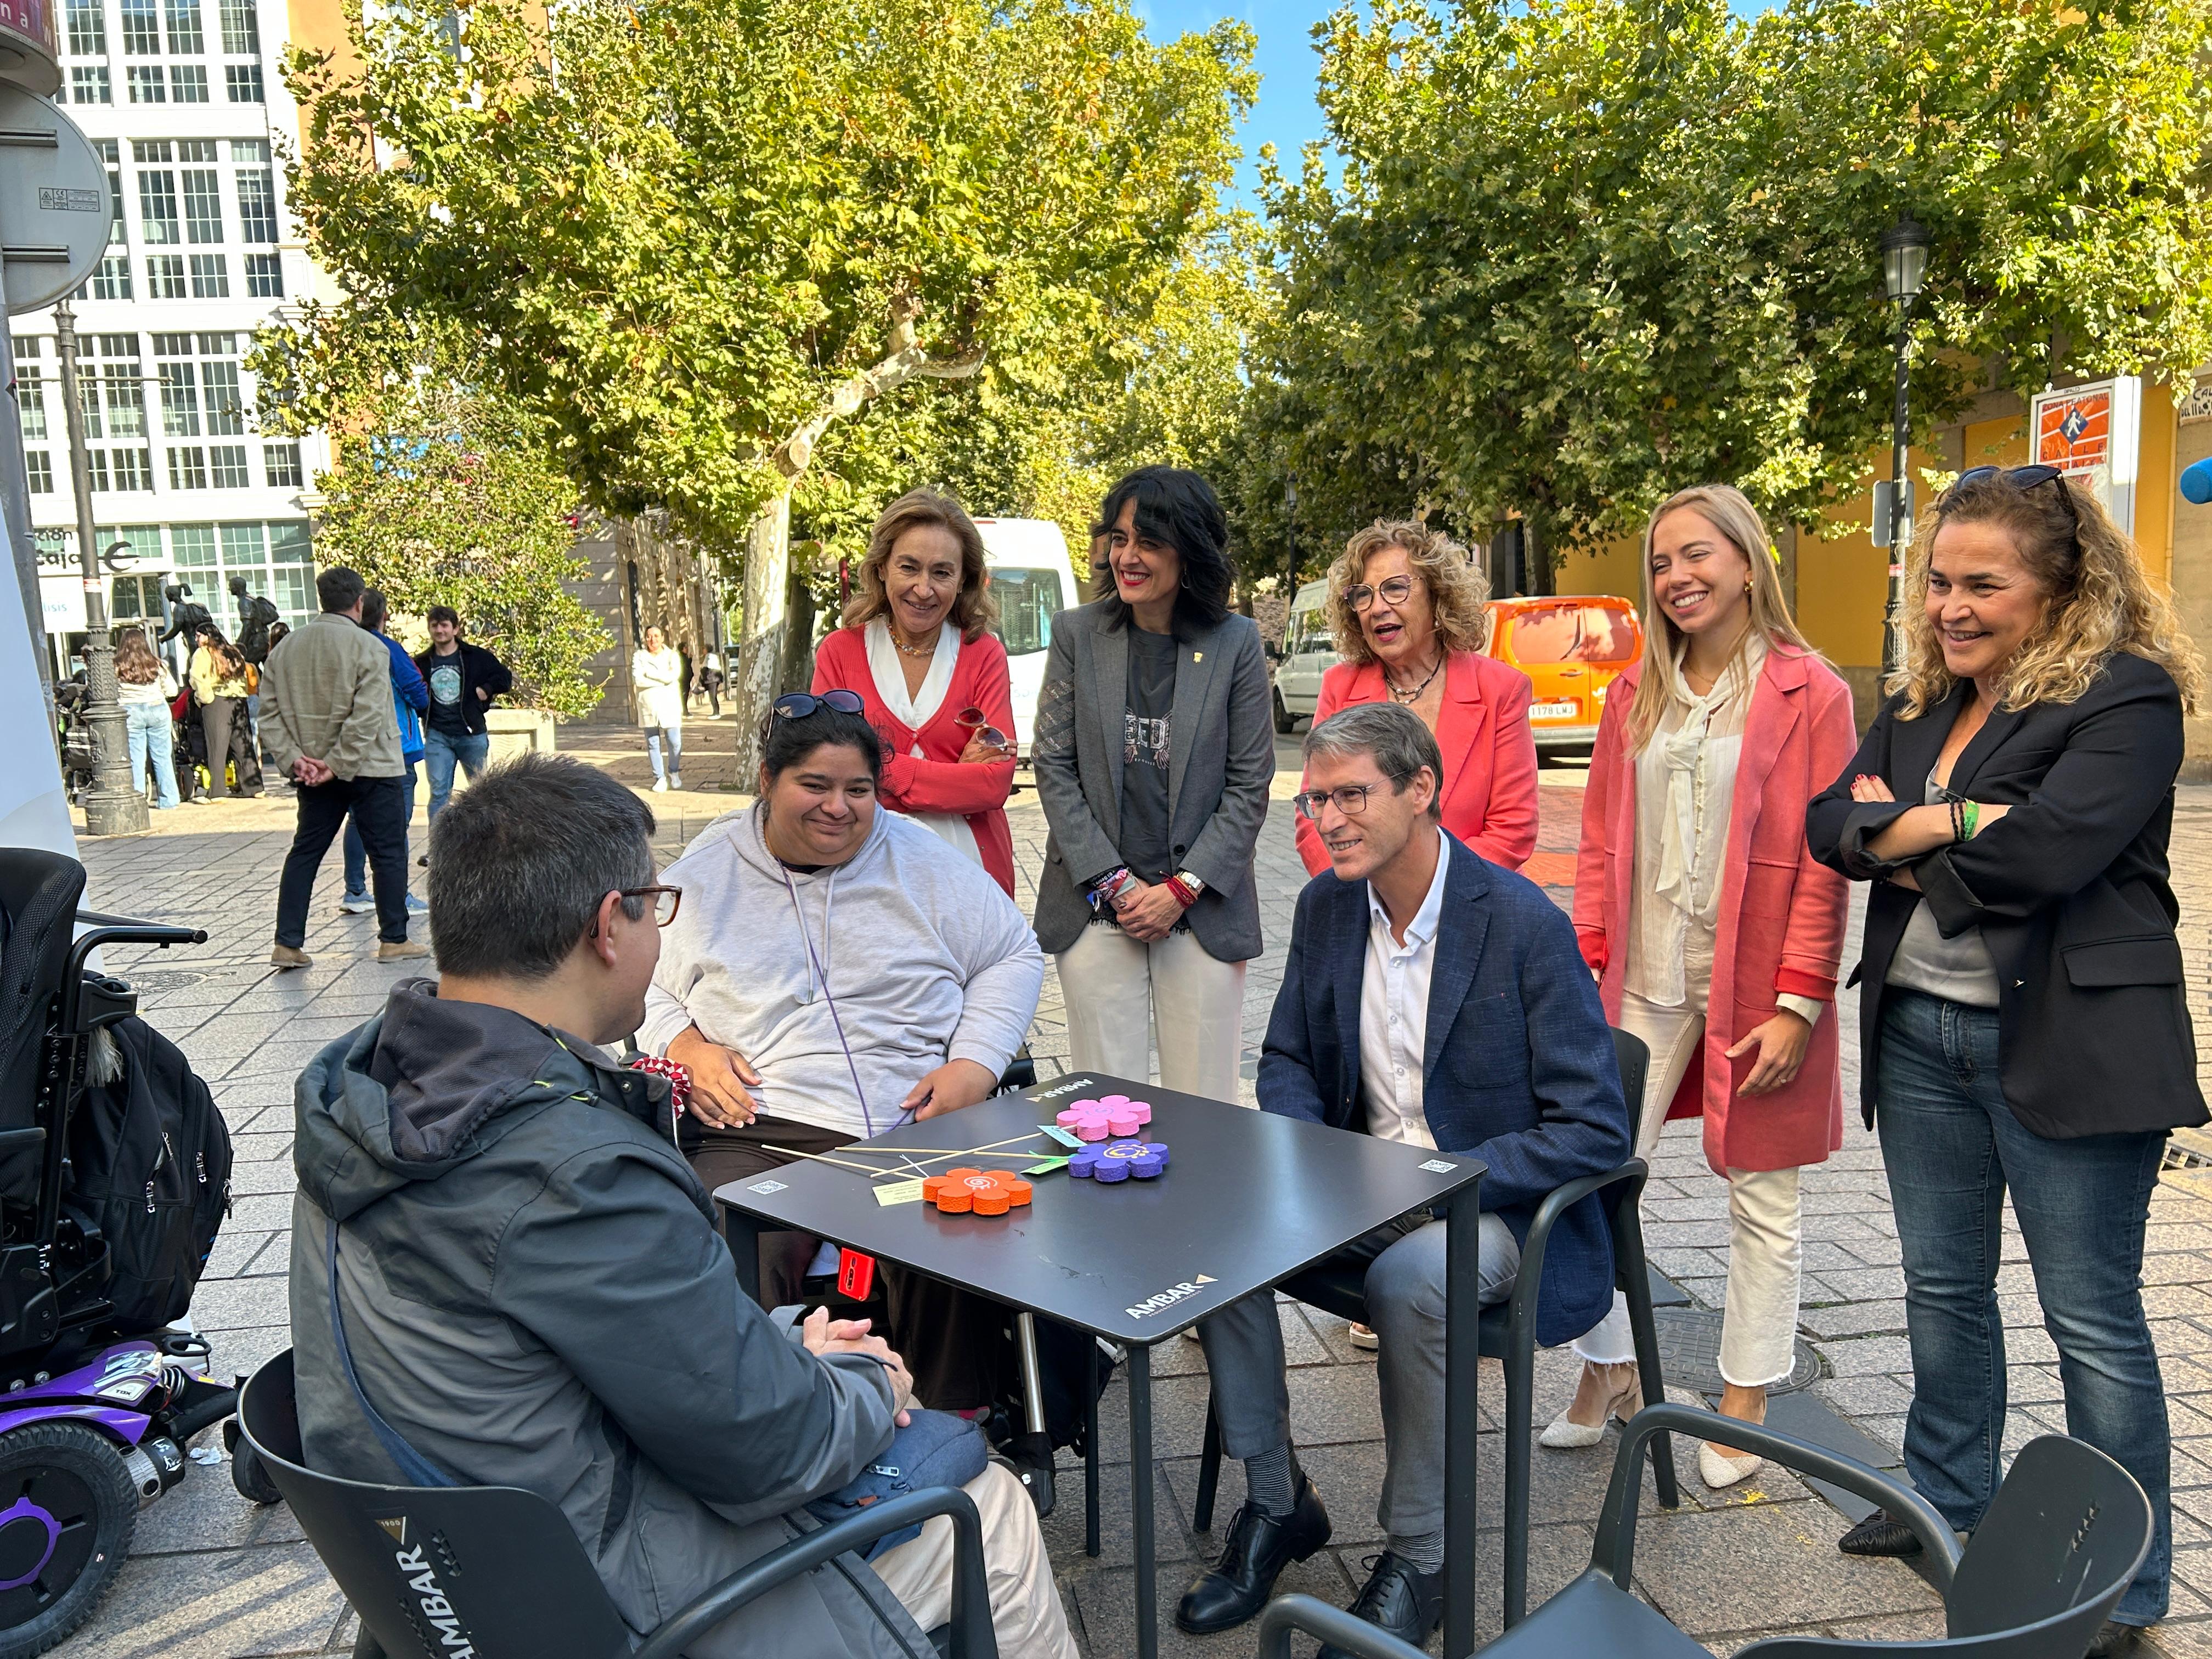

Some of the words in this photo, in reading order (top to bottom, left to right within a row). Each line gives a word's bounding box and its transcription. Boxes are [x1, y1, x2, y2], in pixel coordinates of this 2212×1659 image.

[2066, 392, 2108, 405] PEATONAL
[37, 528, 72, 541] ción
[1532, 706, 1553, 715] 1178
[1556, 705, 1573, 715] LMJ
[1037, 1079, 1093, 1098] AMBAR
[1125, 1282, 1204, 1319] AMBAR
